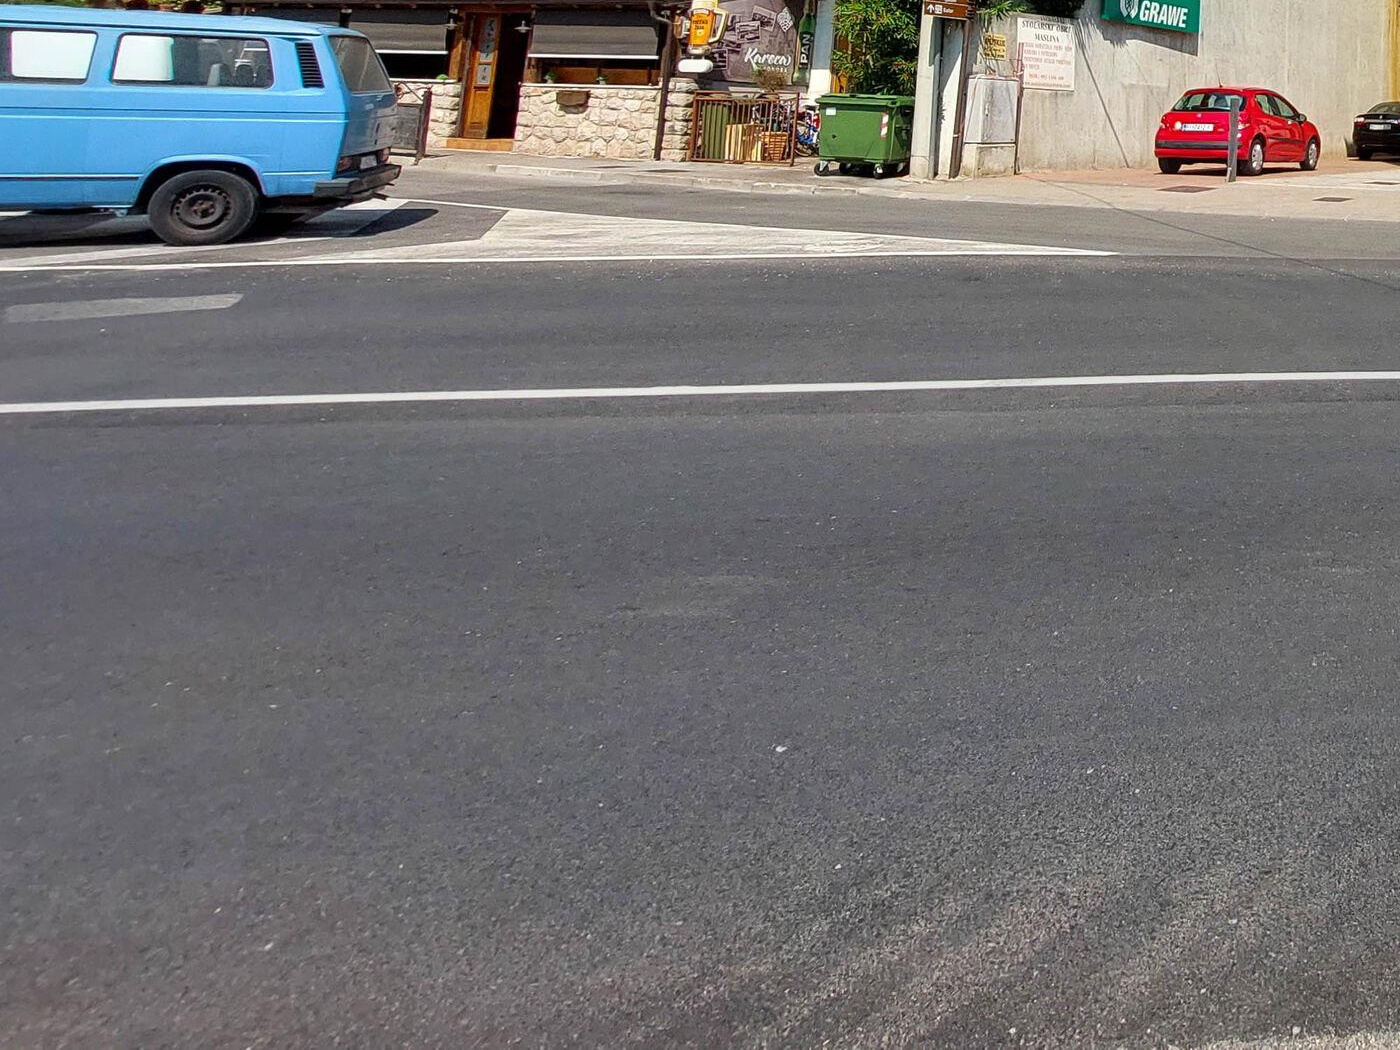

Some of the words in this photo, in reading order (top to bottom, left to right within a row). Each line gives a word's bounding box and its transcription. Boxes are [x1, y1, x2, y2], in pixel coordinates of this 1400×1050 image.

[1139, 0, 1188, 28] GRAWE
[1021, 20, 1055, 31] STOLARSKI
[1034, 33, 1060, 44] MASLINA
[801, 34, 811, 63] PAN
